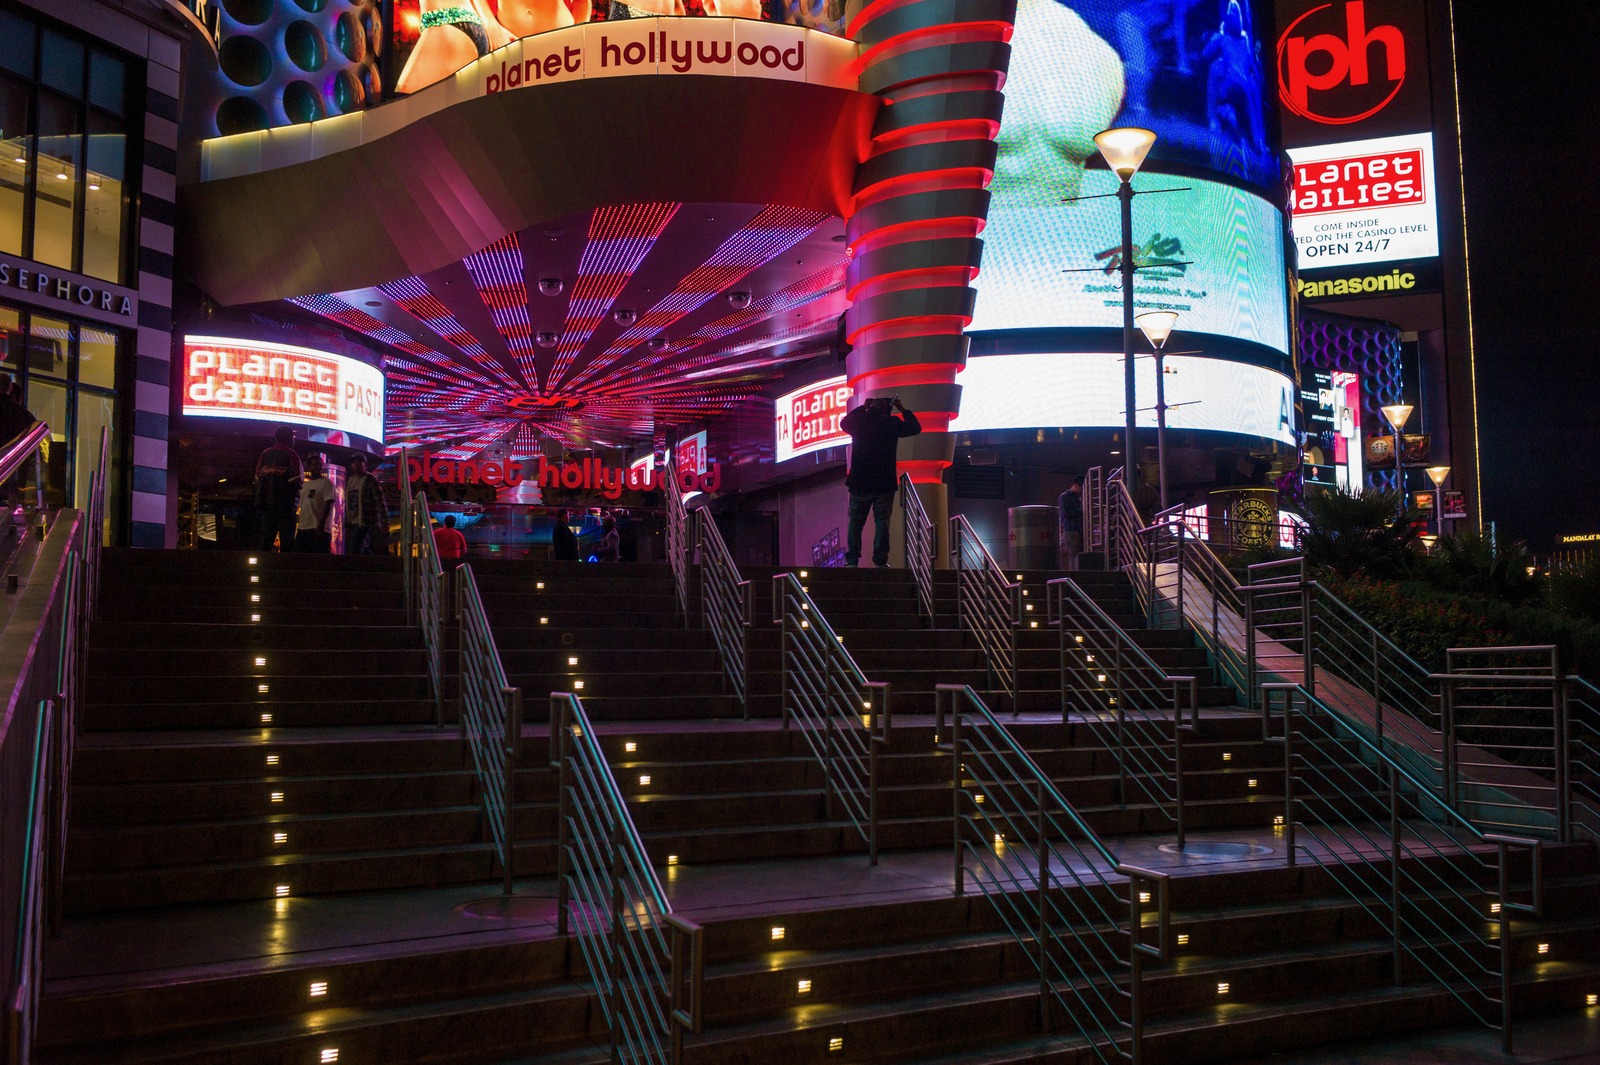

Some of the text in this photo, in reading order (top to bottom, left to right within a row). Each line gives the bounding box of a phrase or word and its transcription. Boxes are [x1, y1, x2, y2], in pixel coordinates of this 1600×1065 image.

[486, 31, 804, 95] planet hollywood
[1314, 219, 1379, 232] COME INSIDE
[1316, 234, 1332, 242] ON
[1336, 231, 1353, 240] THE
[1357, 227, 1397, 238] CASINO
[1400, 224, 1428, 234] LEVEL
[1306, 238, 1390, 257] OPEN 24/7
[0, 263, 132, 316] SEPHORA
